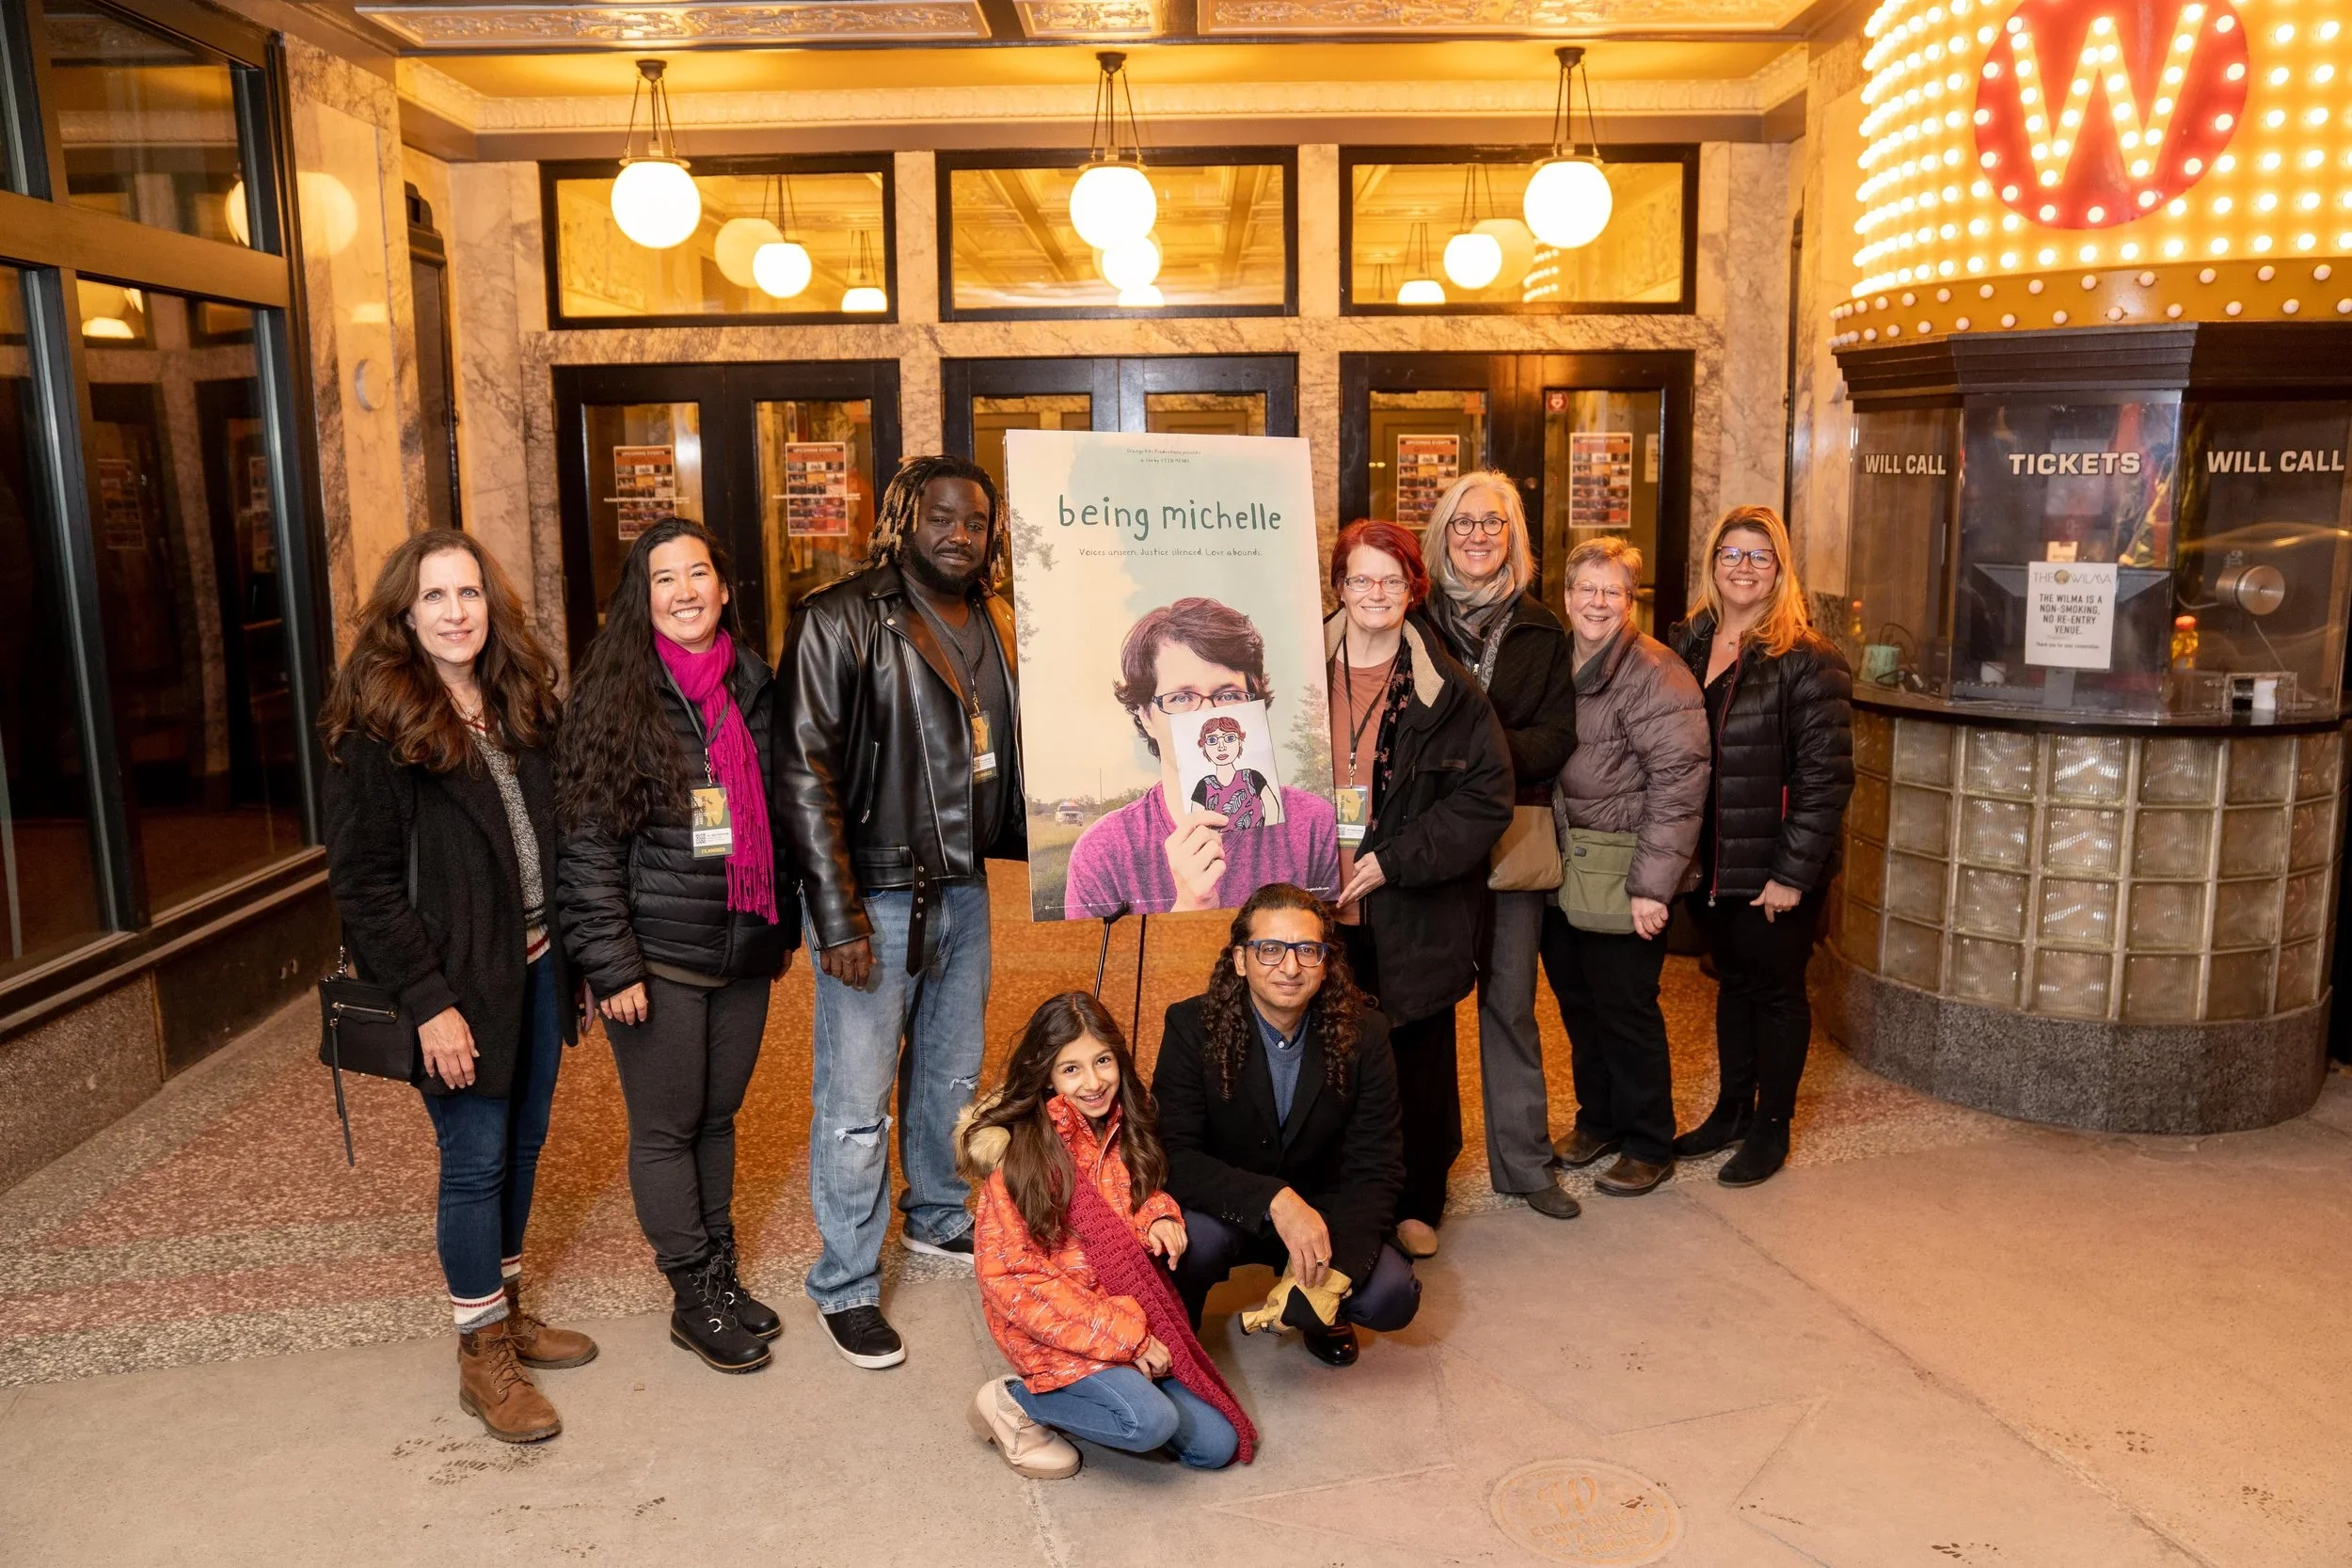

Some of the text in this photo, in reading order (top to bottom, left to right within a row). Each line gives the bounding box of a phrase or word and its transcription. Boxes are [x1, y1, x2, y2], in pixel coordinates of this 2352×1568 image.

[2007, 3, 2208, 188] W
[1865, 454, 1947, 475] WILL CALL
[2008, 451, 2140, 475] TICKETS
[2206, 450, 2345, 473] WILL CALL
[1059, 494, 1281, 541] being michelle
[1078, 547, 1105, 556] Voices
[1140, 547, 1168, 556] Justice
[2033, 572, 2112, 583] THE WILMA
[2040, 594, 2103, 604] THE WILMA IS A
[2042, 614, 2097, 625] NO RE-ENTRY
[2055, 626, 2082, 635] VENUE.
